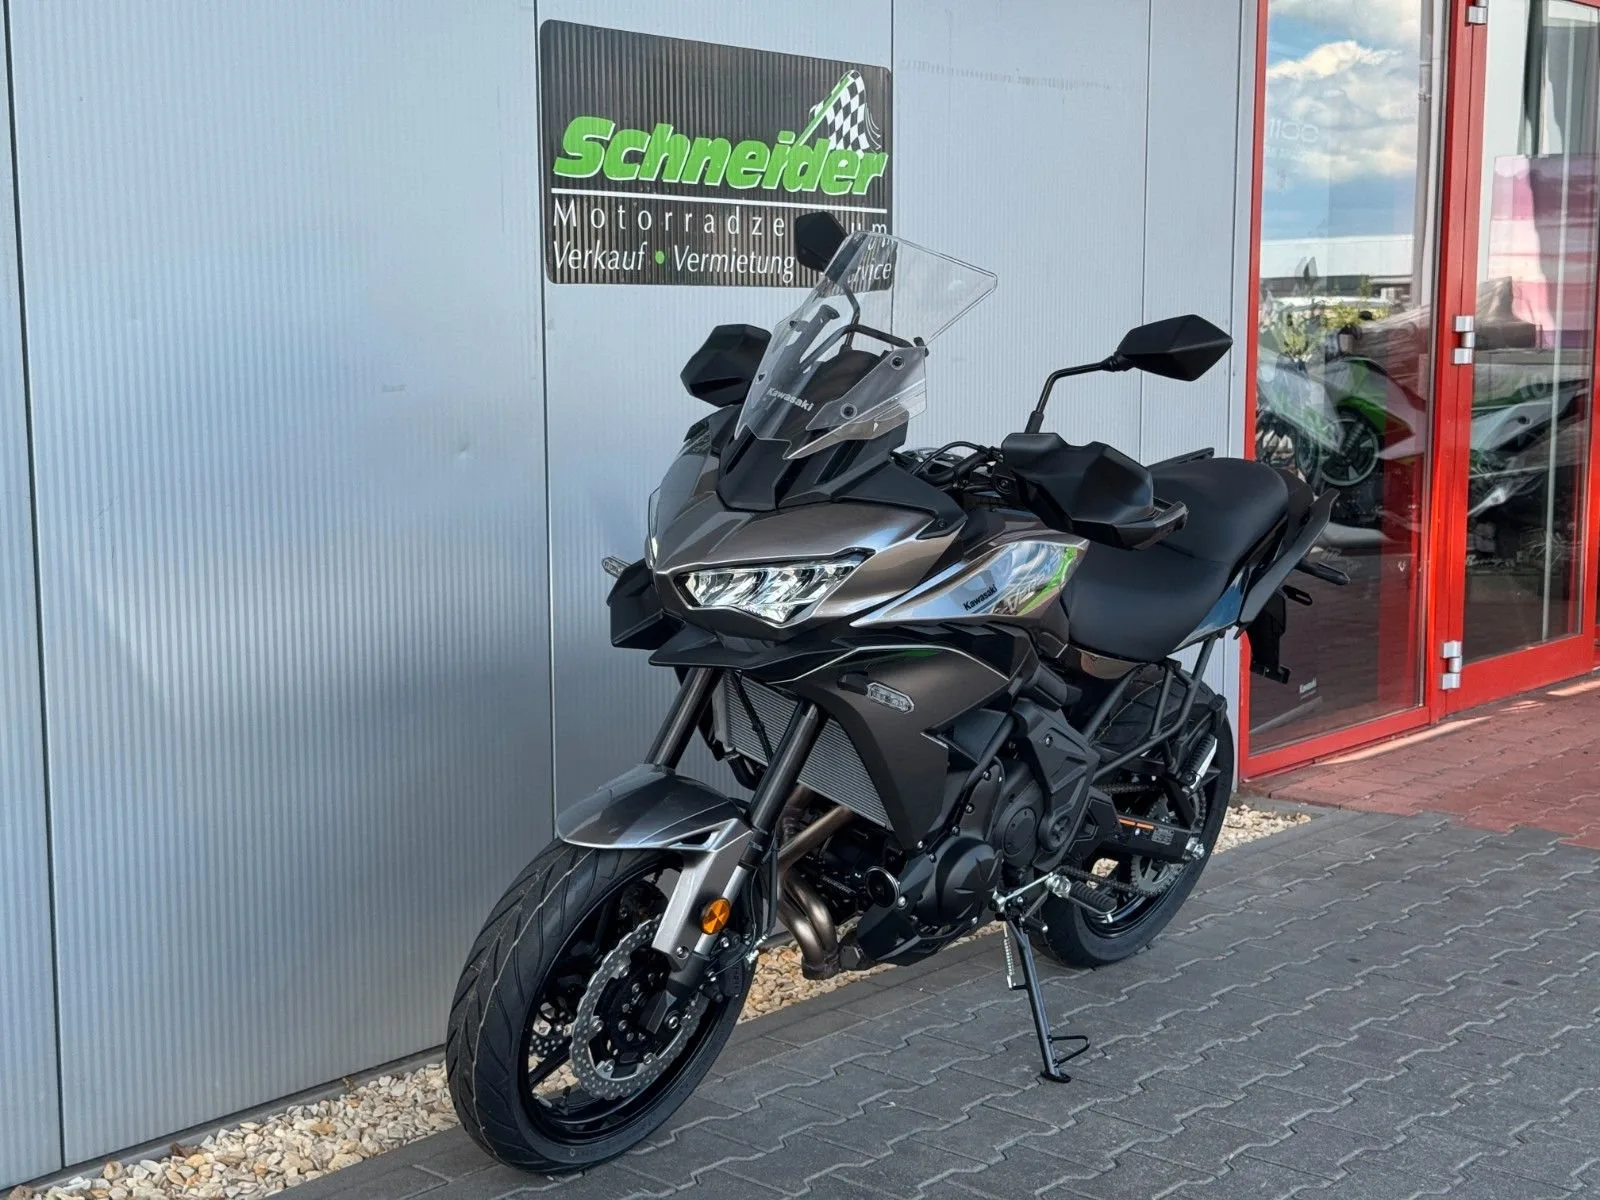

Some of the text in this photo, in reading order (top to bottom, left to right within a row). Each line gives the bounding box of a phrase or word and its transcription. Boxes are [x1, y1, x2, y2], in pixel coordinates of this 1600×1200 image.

[553, 116, 888, 195] Schneider
[553, 198, 887, 240] Motorradzeum
[554, 240, 648, 271] Verkauf
[674, 244, 795, 283] Vermietung
[766, 387, 815, 412] Kawasaki
[962, 584, 998, 611] Kawasaki
